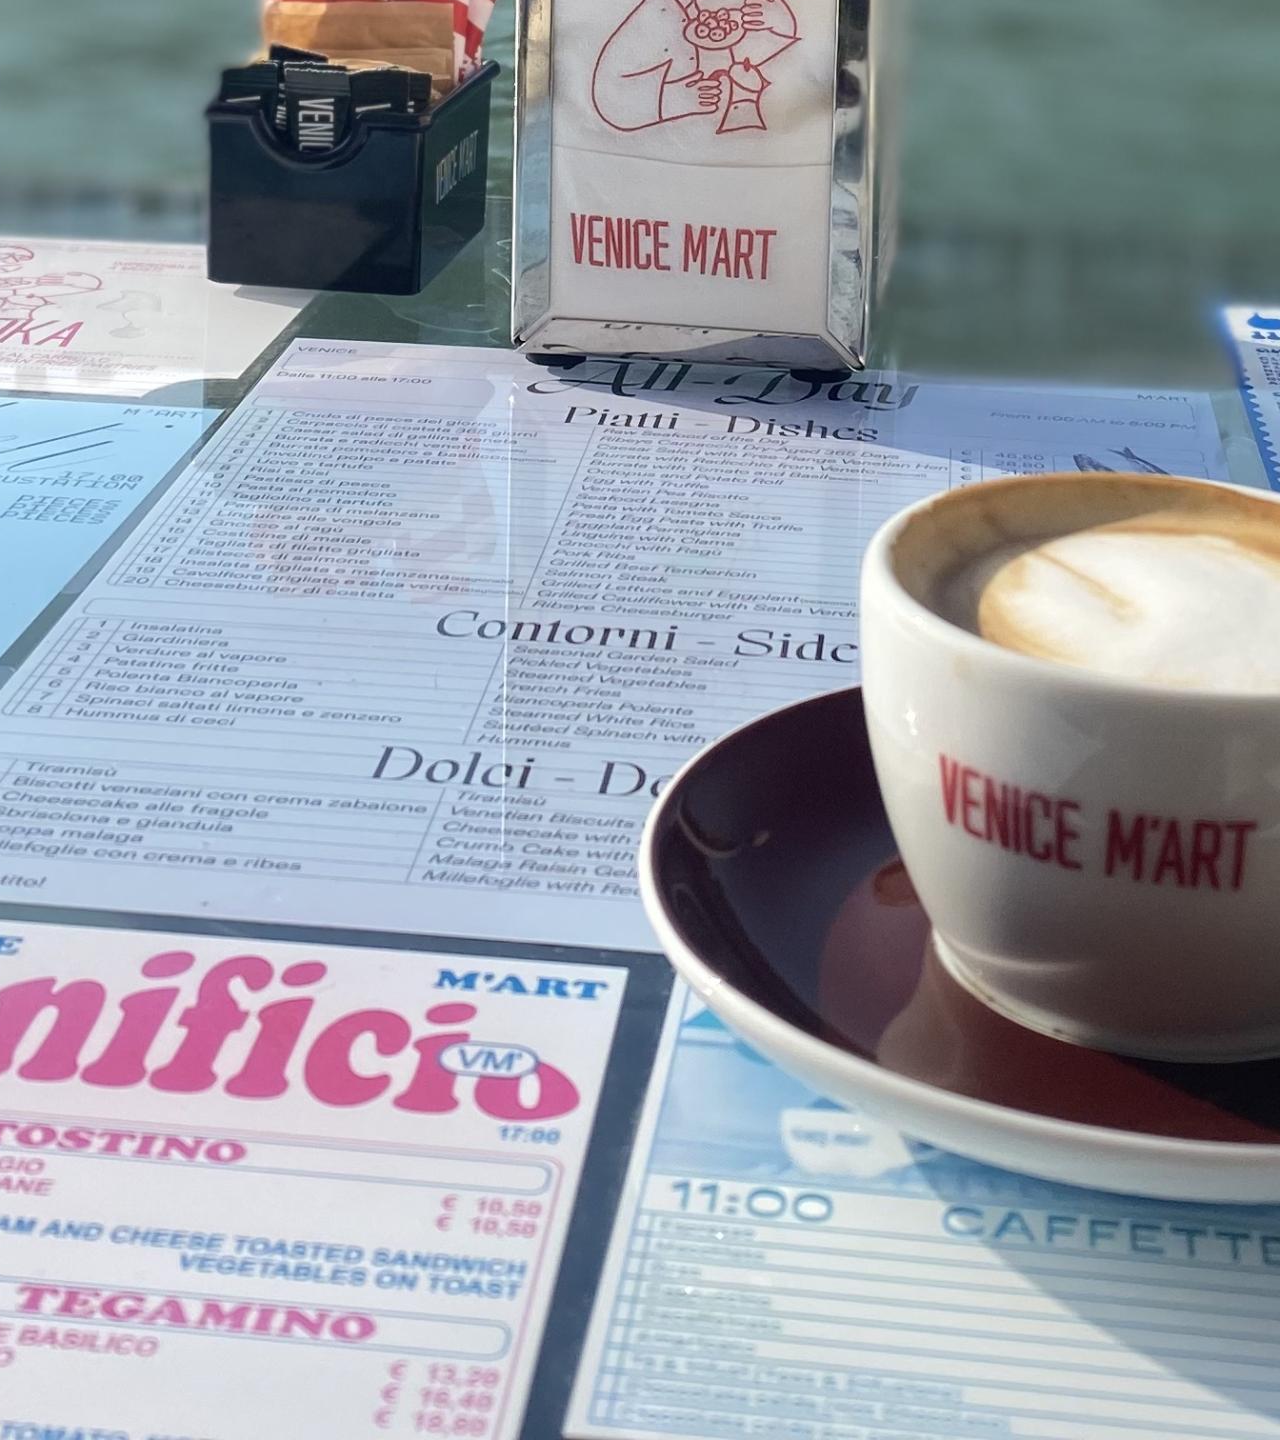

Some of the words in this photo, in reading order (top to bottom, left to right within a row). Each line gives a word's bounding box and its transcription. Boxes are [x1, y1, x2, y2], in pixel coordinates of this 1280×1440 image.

[570, 212, 670, 271] VENICE
[683, 223, 777, 280] M'ART
[297, 345, 358, 355] VENICE
[319, 372, 358, 382] 11:00
[391, 377, 433, 385] 17:00
[563, 405, 680, 430] Piatti
[581, 476, 618, 489] Egg
[621, 477, 657, 488] with
[0, 511, 107, 525] PIECES
[531, 600, 597, 614] Ribeye
[600, 604, 735, 621] Cheeseburger
[122, 633, 230, 648] Giardiniera
[435, 610, 679, 650] Contorni
[103, 656, 187, 670] Patatine
[94, 668, 171, 682] Polenta
[176, 673, 299, 690] Biancoperla
[504, 668, 597, 684] Steamed
[599, 674, 709, 691] Vegetables
[64, 706, 161, 722] Hummus
[165, 711, 186, 723] di
[189, 715, 238, 727] ceci
[74, 694, 154, 709] Spinaci
[156, 698, 221, 712] saltati
[225, 703, 298, 717] limone
[319, 711, 403, 724] zenzero
[24, 759, 119, 778] Tiramisù
[372, 745, 536, 789] Dolci
[0, 790, 140, 810] Cheesecake
[144, 799, 185, 813] alle
[189, 803, 270, 819] fragole
[12, 775, 98, 792] Biscotti
[99, 781, 202, 799] veneziani
[206, 789, 256, 802] con
[260, 794, 323, 807] crema
[327, 797, 429, 814] zabaione
[450, 805, 545, 823] Venetian
[549, 811, 636, 830] Biscuits
[939, 753, 1083, 871] VENICE
[1105, 810, 1258, 892] M'ART
[59, 826, 145, 844] malaga
[434, 968, 610, 1001] M'ART
[497, 1125, 561, 1144] 17:00
[669, 1179, 835, 1224] 11:00
[41, 1218, 104, 1242] AND
[109, 1224, 223, 1254] CHEESE
[233, 1234, 364, 1264] TOASTED
[370, 1246, 529, 1280] SANDWICH
[178, 1252, 367, 1288] VEGETABLES
[374, 1266, 419, 1290] ON
[426, 1273, 523, 1301] TOAST
[16, 1283, 378, 1342] TEGAMINO
[16, 1325, 161, 1358] BASILICO
